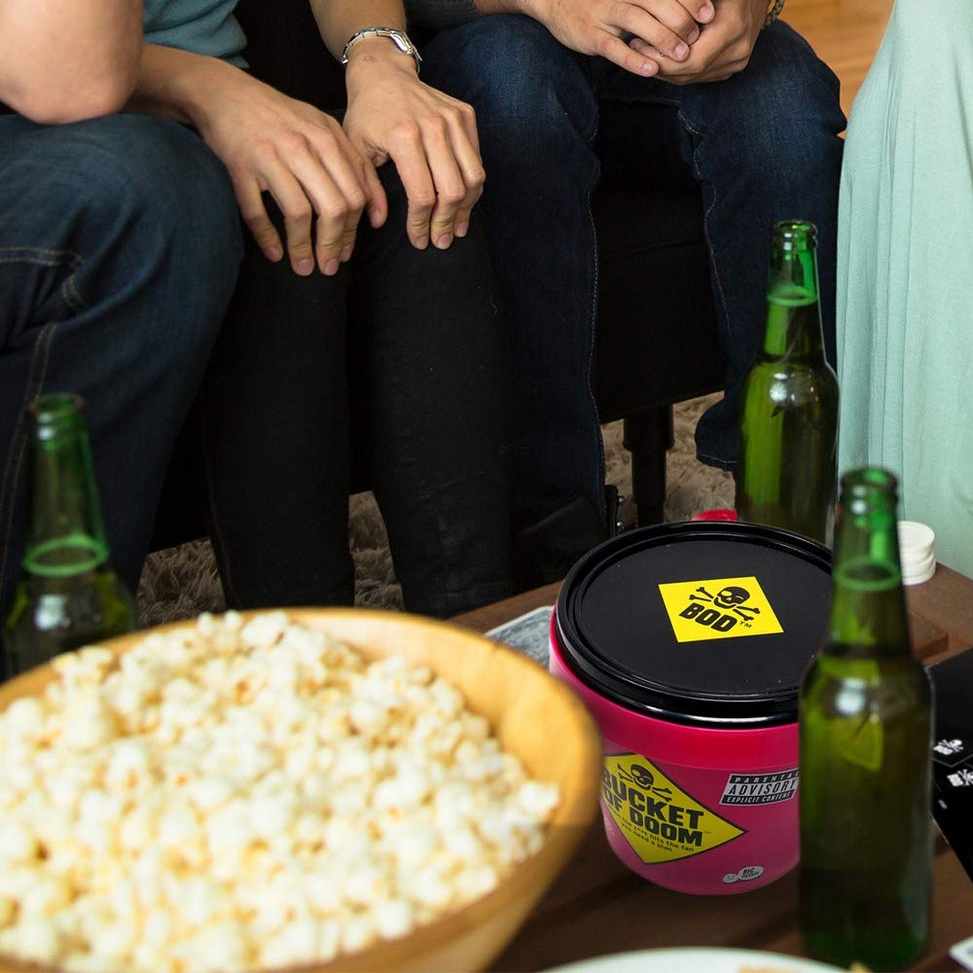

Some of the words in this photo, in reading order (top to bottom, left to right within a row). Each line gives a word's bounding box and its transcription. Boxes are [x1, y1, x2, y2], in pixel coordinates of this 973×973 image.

[678, 602, 738, 632] BOD
[602, 768, 704, 830] BUCKET
[602, 786, 623, 812] OF
[728, 777, 799, 796] ADVISORY
[762, 791, 791, 802] CONTENT
[630, 807, 703, 847] DOOM
[681, 844, 694, 852] fan
